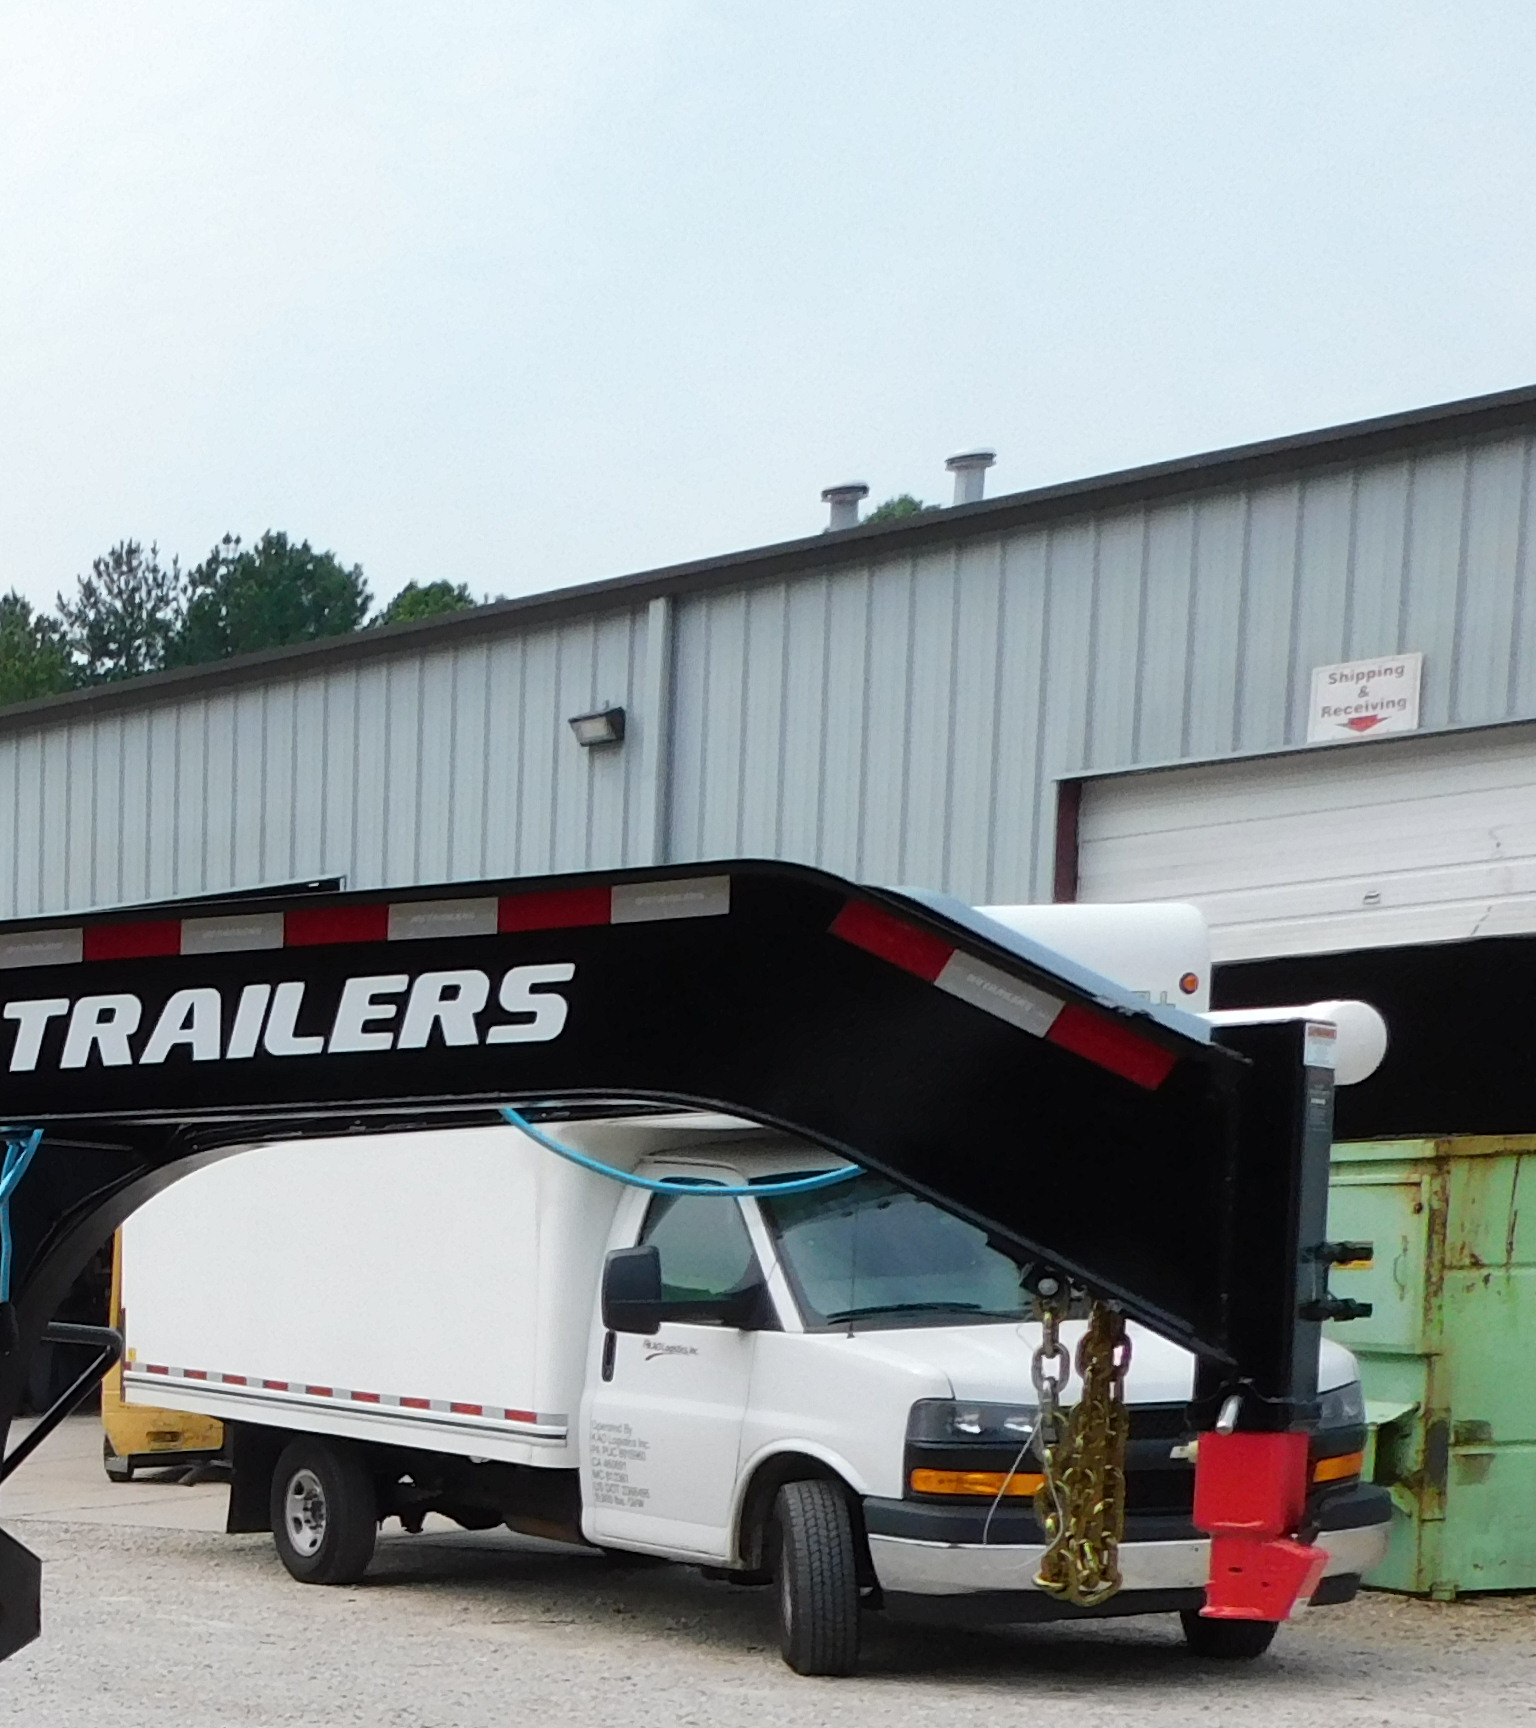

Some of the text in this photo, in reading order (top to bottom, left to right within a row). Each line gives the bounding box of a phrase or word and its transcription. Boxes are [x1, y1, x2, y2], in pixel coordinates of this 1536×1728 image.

[1328, 664, 1406, 685] Shipping
[1358, 685, 1369, 698] &
[1320, 697, 1408, 718] Receiving
[2, 962, 576, 1073] TRAILERS
